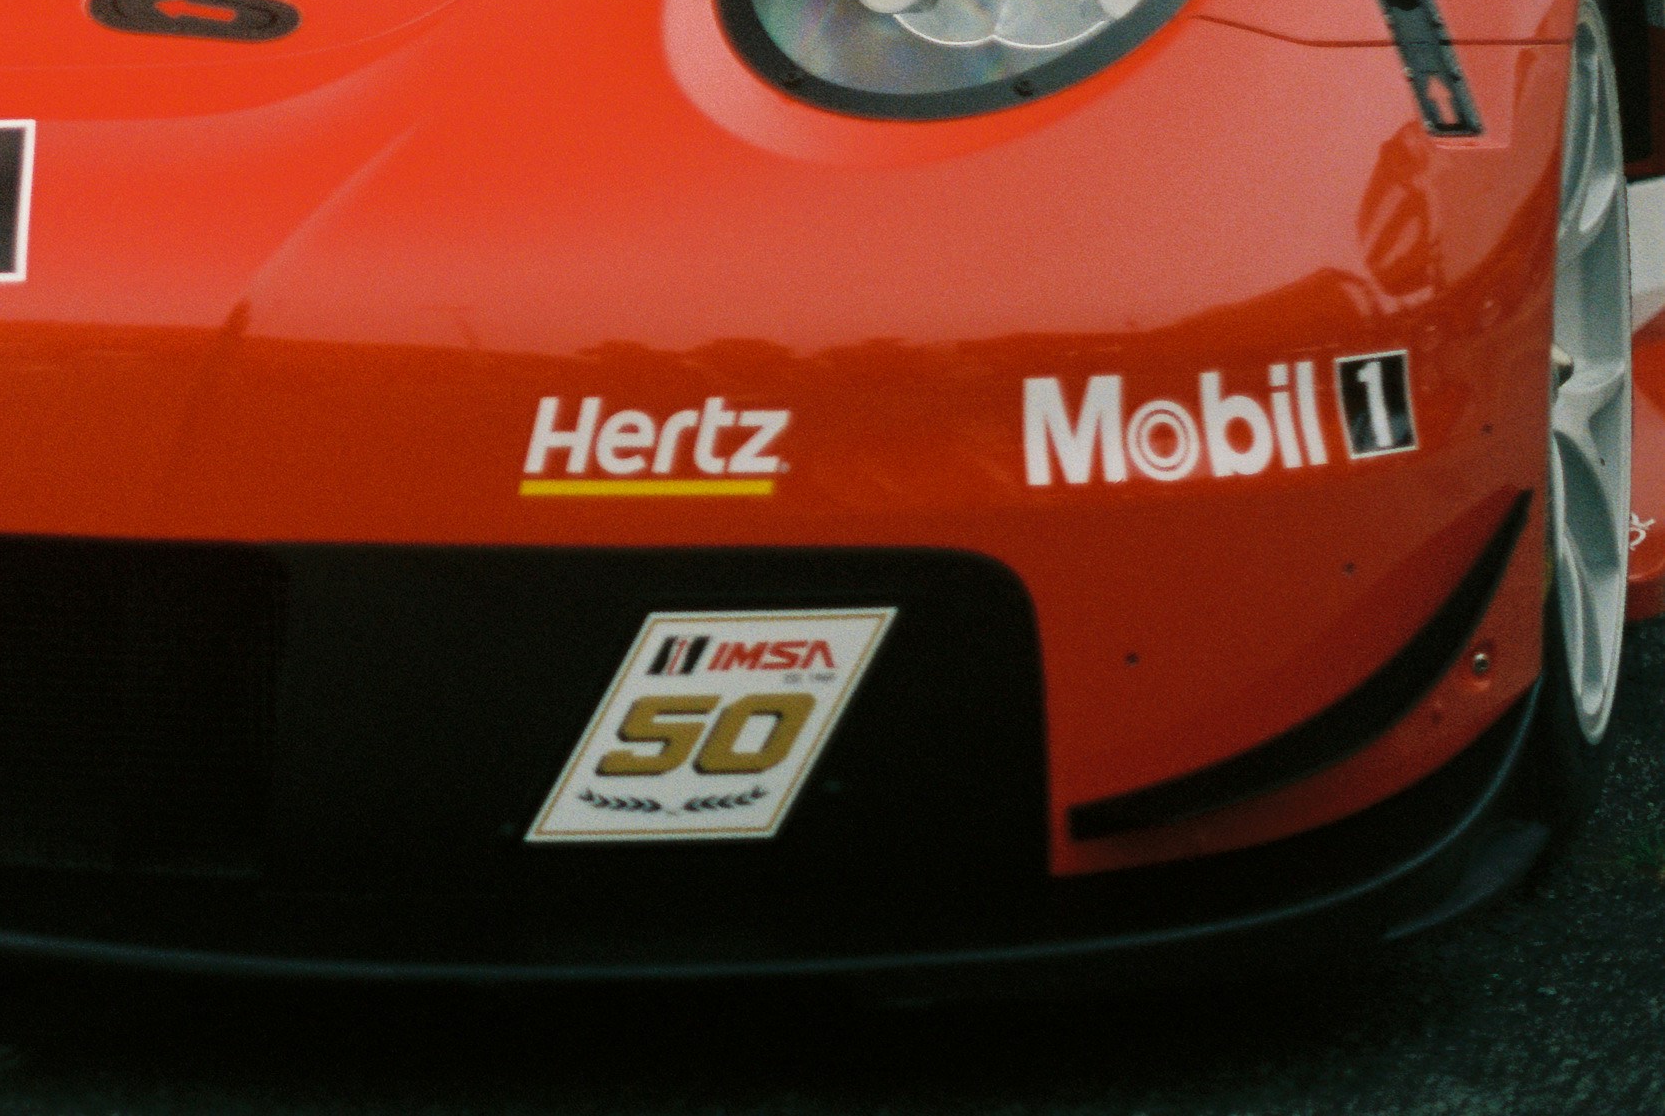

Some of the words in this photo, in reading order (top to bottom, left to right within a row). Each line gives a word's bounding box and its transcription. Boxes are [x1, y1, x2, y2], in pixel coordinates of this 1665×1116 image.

[523, 395, 791, 475] Hertz
[1021, 360, 1329, 486] Mobil
[1357, 359, 1397, 449] 1
[707, 639, 836, 671] IMSA
[595, 692, 817, 777] 50
